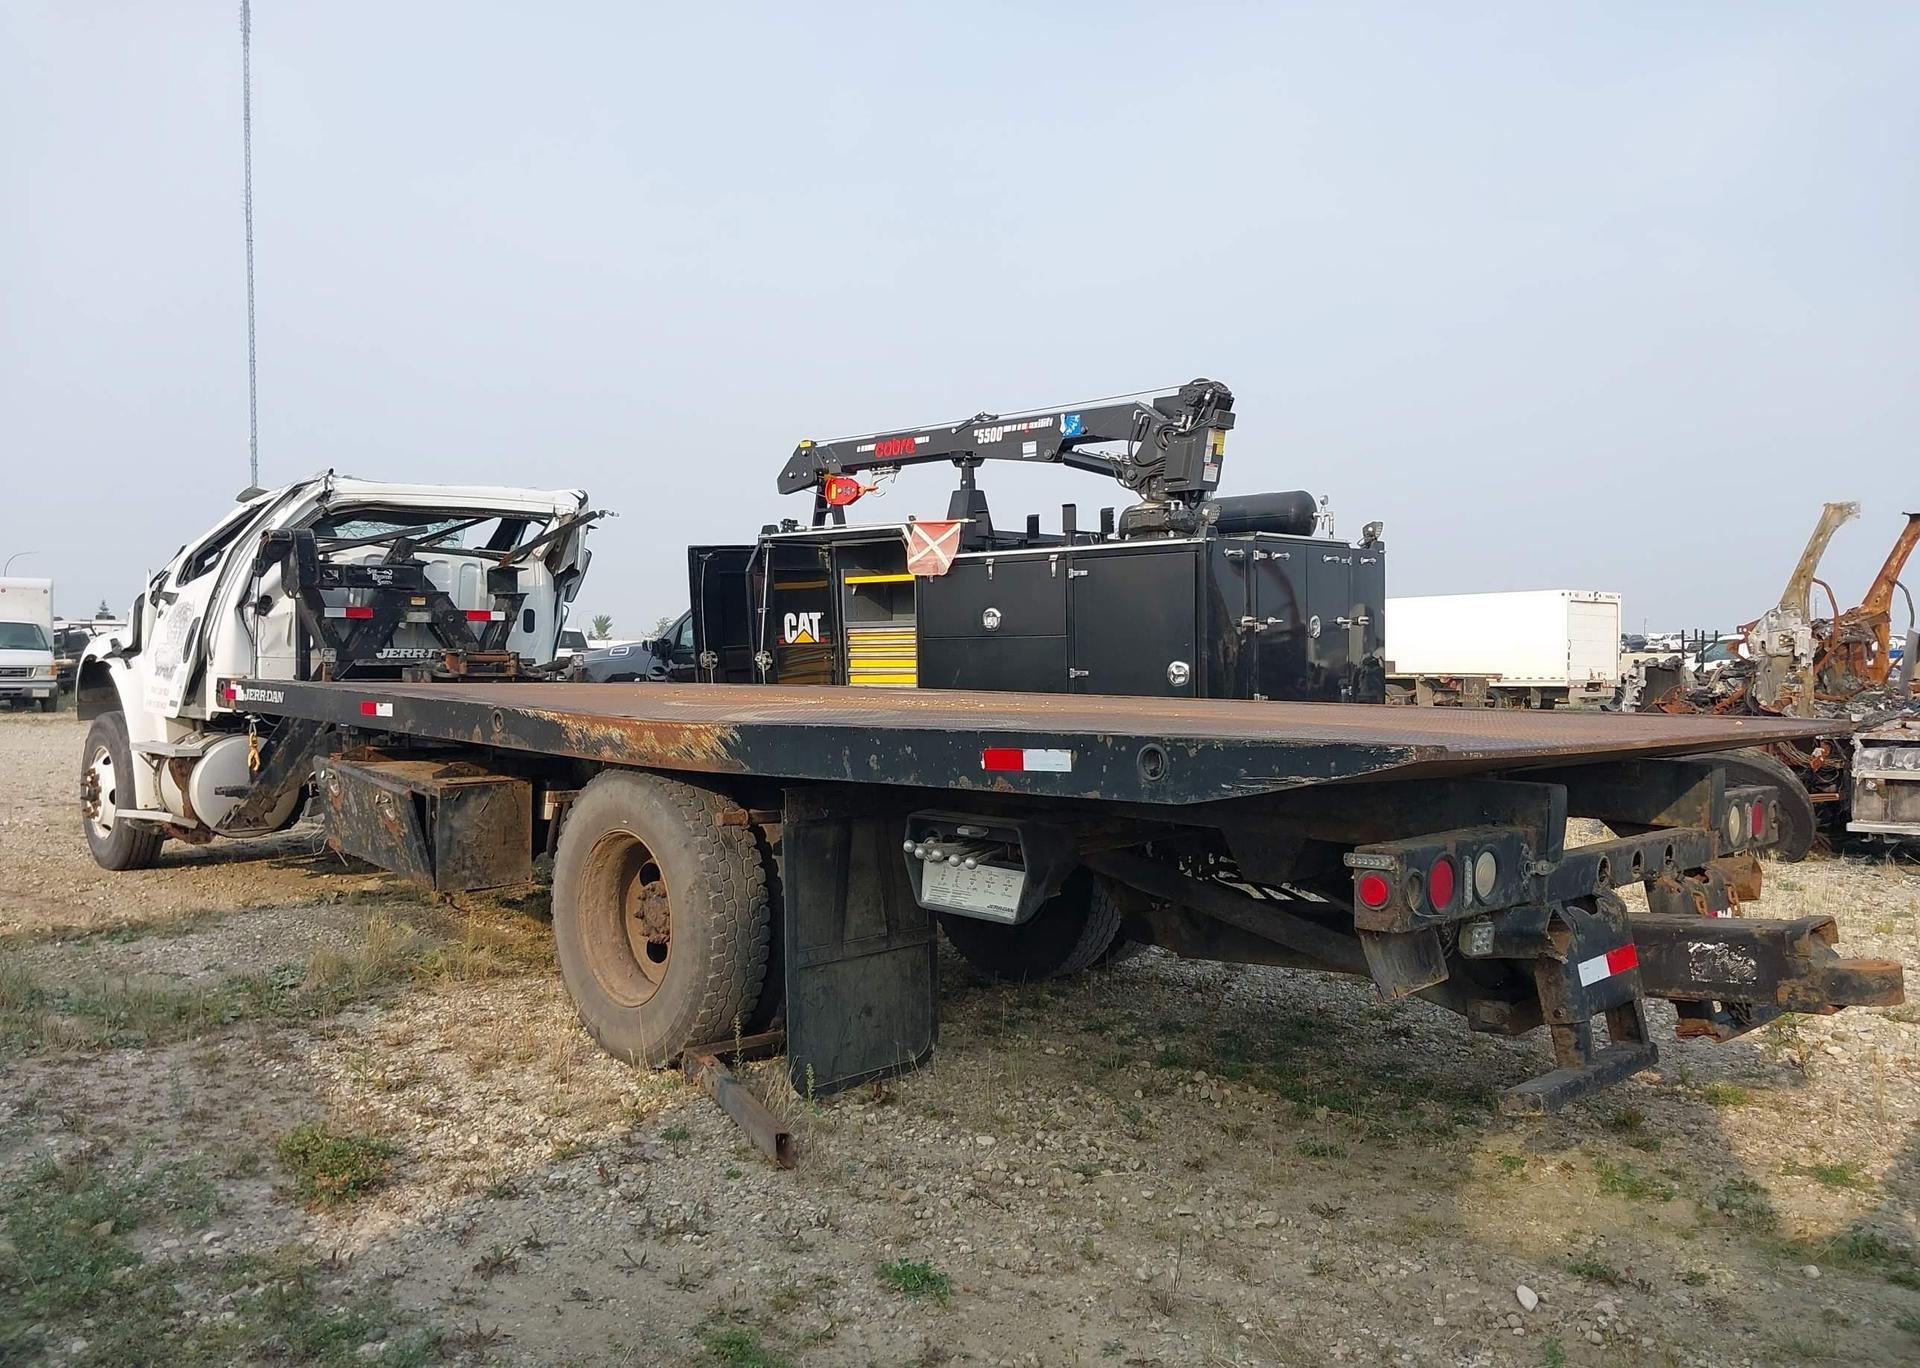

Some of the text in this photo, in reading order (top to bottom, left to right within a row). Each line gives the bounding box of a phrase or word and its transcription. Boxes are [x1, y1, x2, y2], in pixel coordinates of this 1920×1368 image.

[977, 426, 1003, 444] 5500
[875, 437, 916, 459] cobra
[784, 612, 821, 644] CAT
